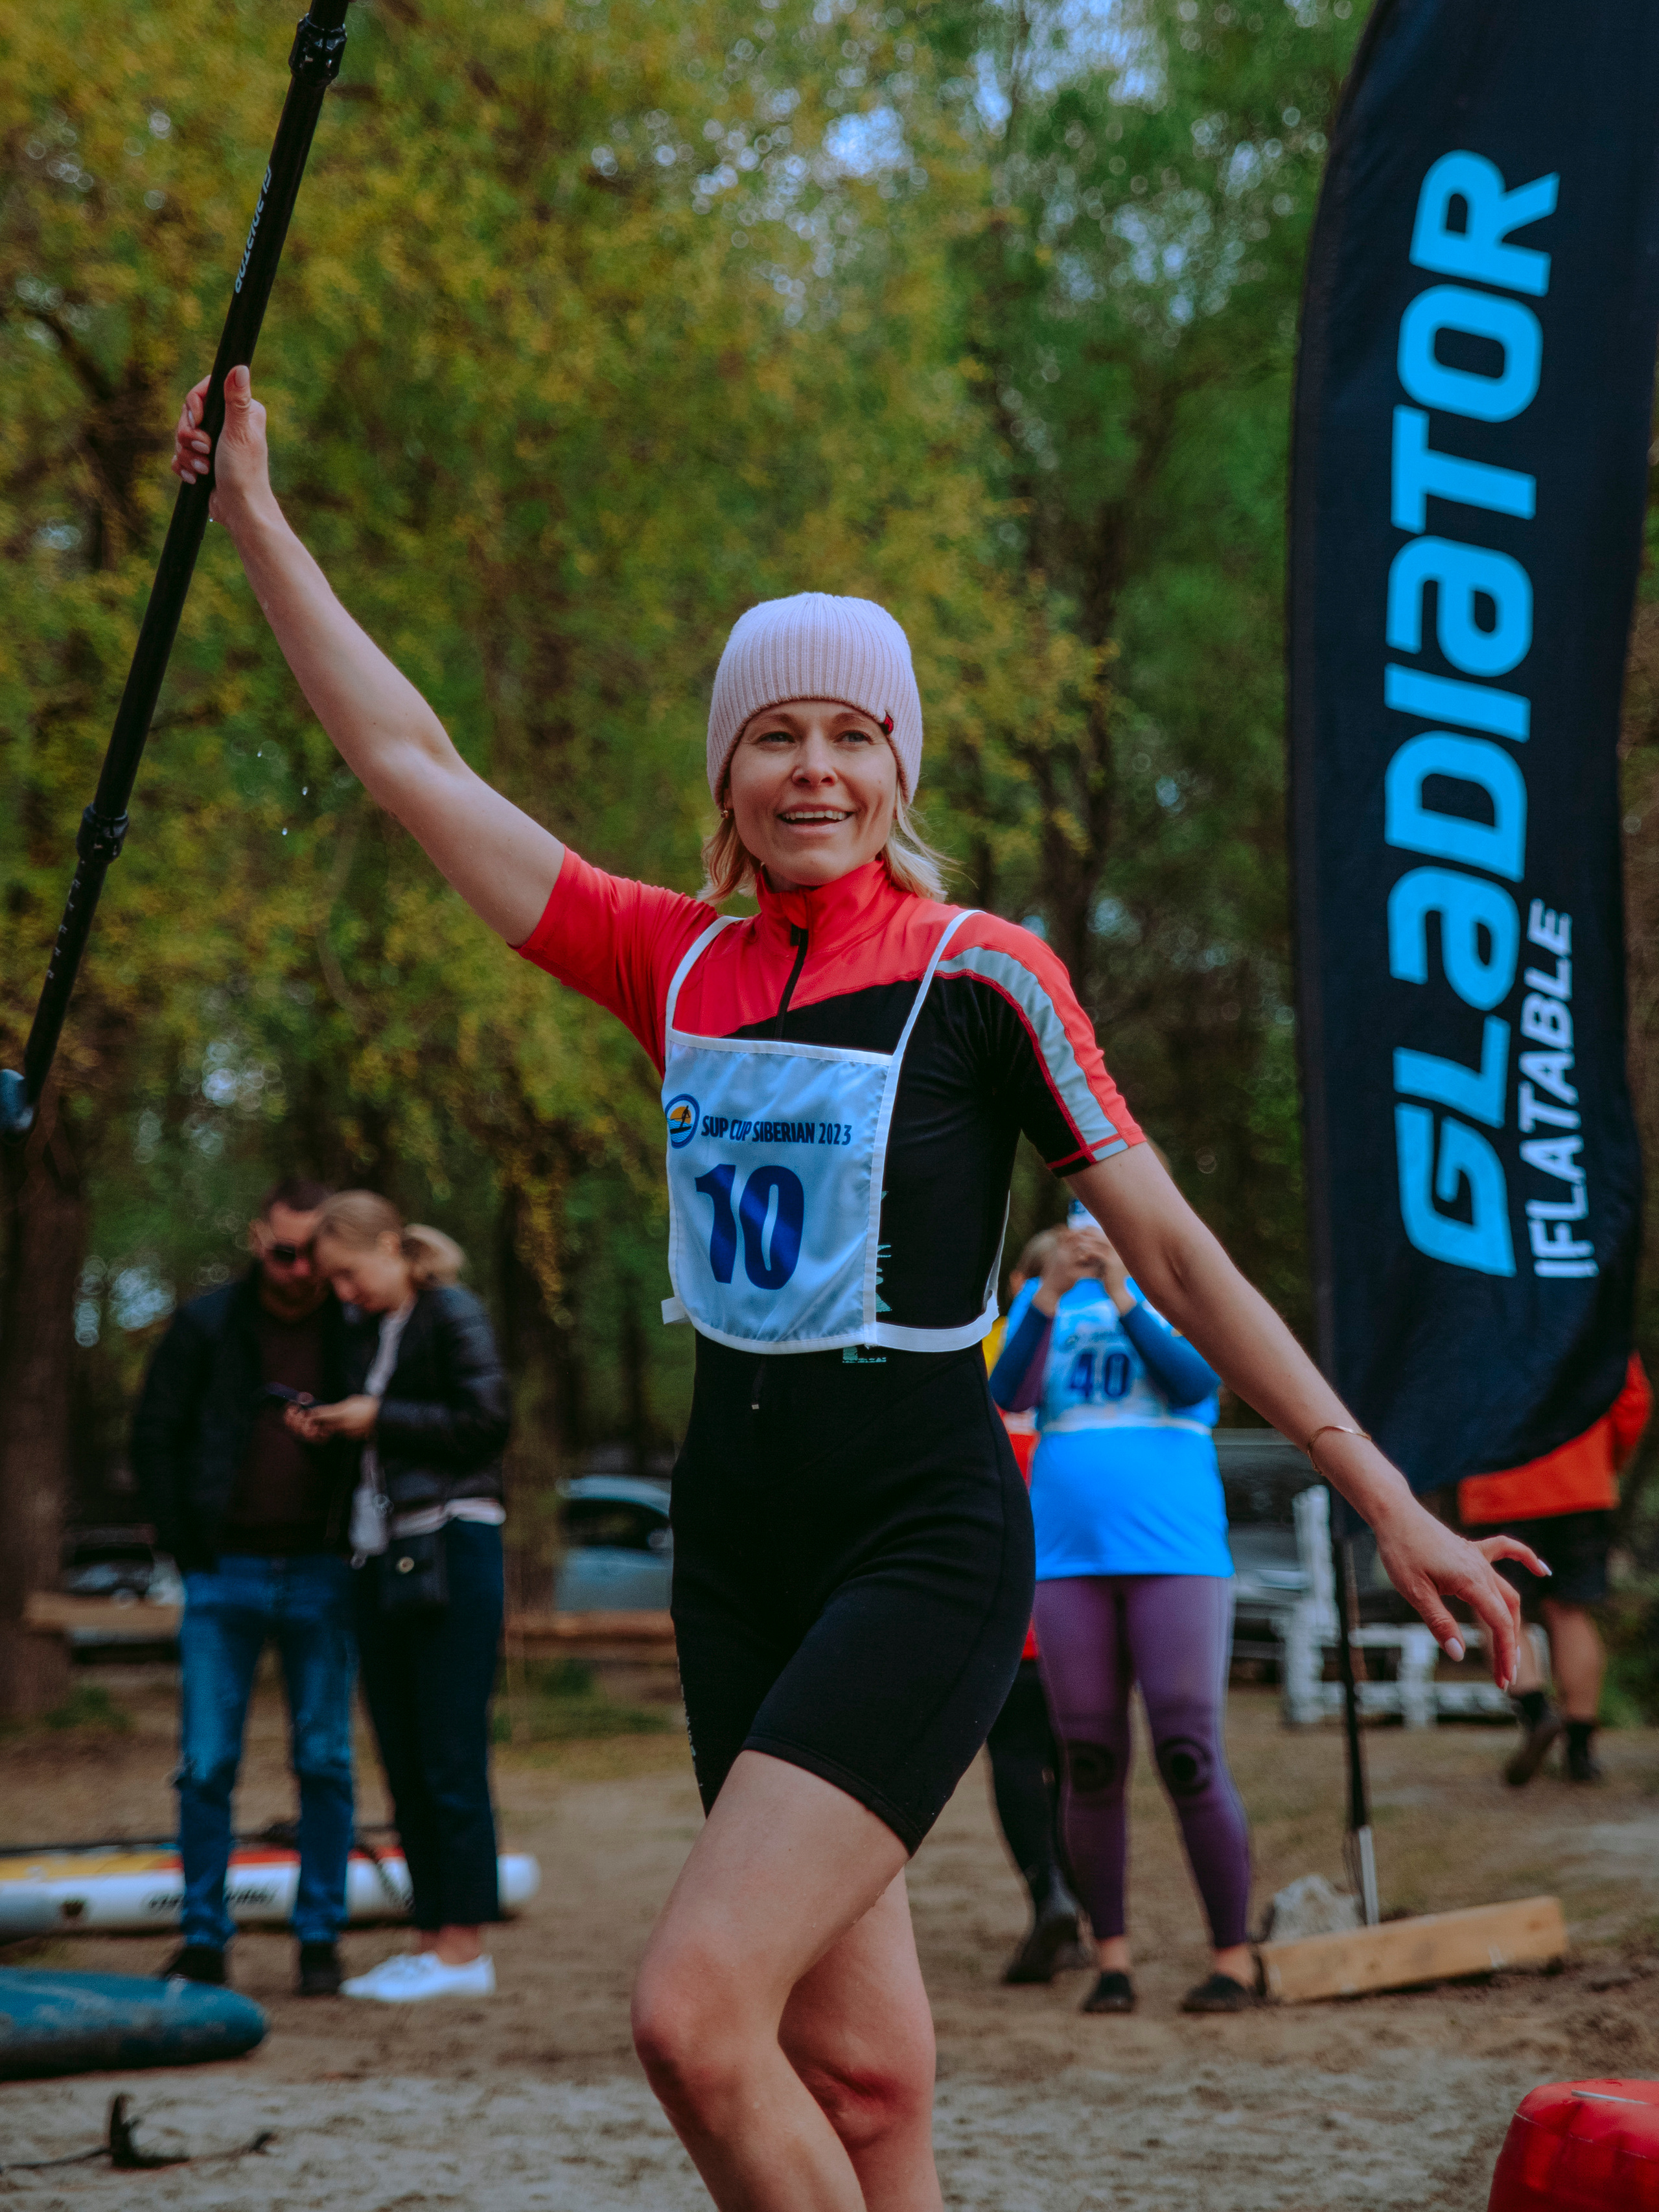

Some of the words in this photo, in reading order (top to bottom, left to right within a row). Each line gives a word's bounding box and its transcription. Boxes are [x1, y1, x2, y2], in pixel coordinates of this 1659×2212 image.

[701, 1115, 728, 1138] SUP
[729, 1119, 752, 1141] CUP
[752, 1121, 815, 1144] SIBERIAN
[818, 1122, 852, 1146] 2023
[1518, 898, 1599, 1279] IFLATABLE
[694, 1163, 805, 1290] 10
[1069, 1351, 1130, 1401] 40
